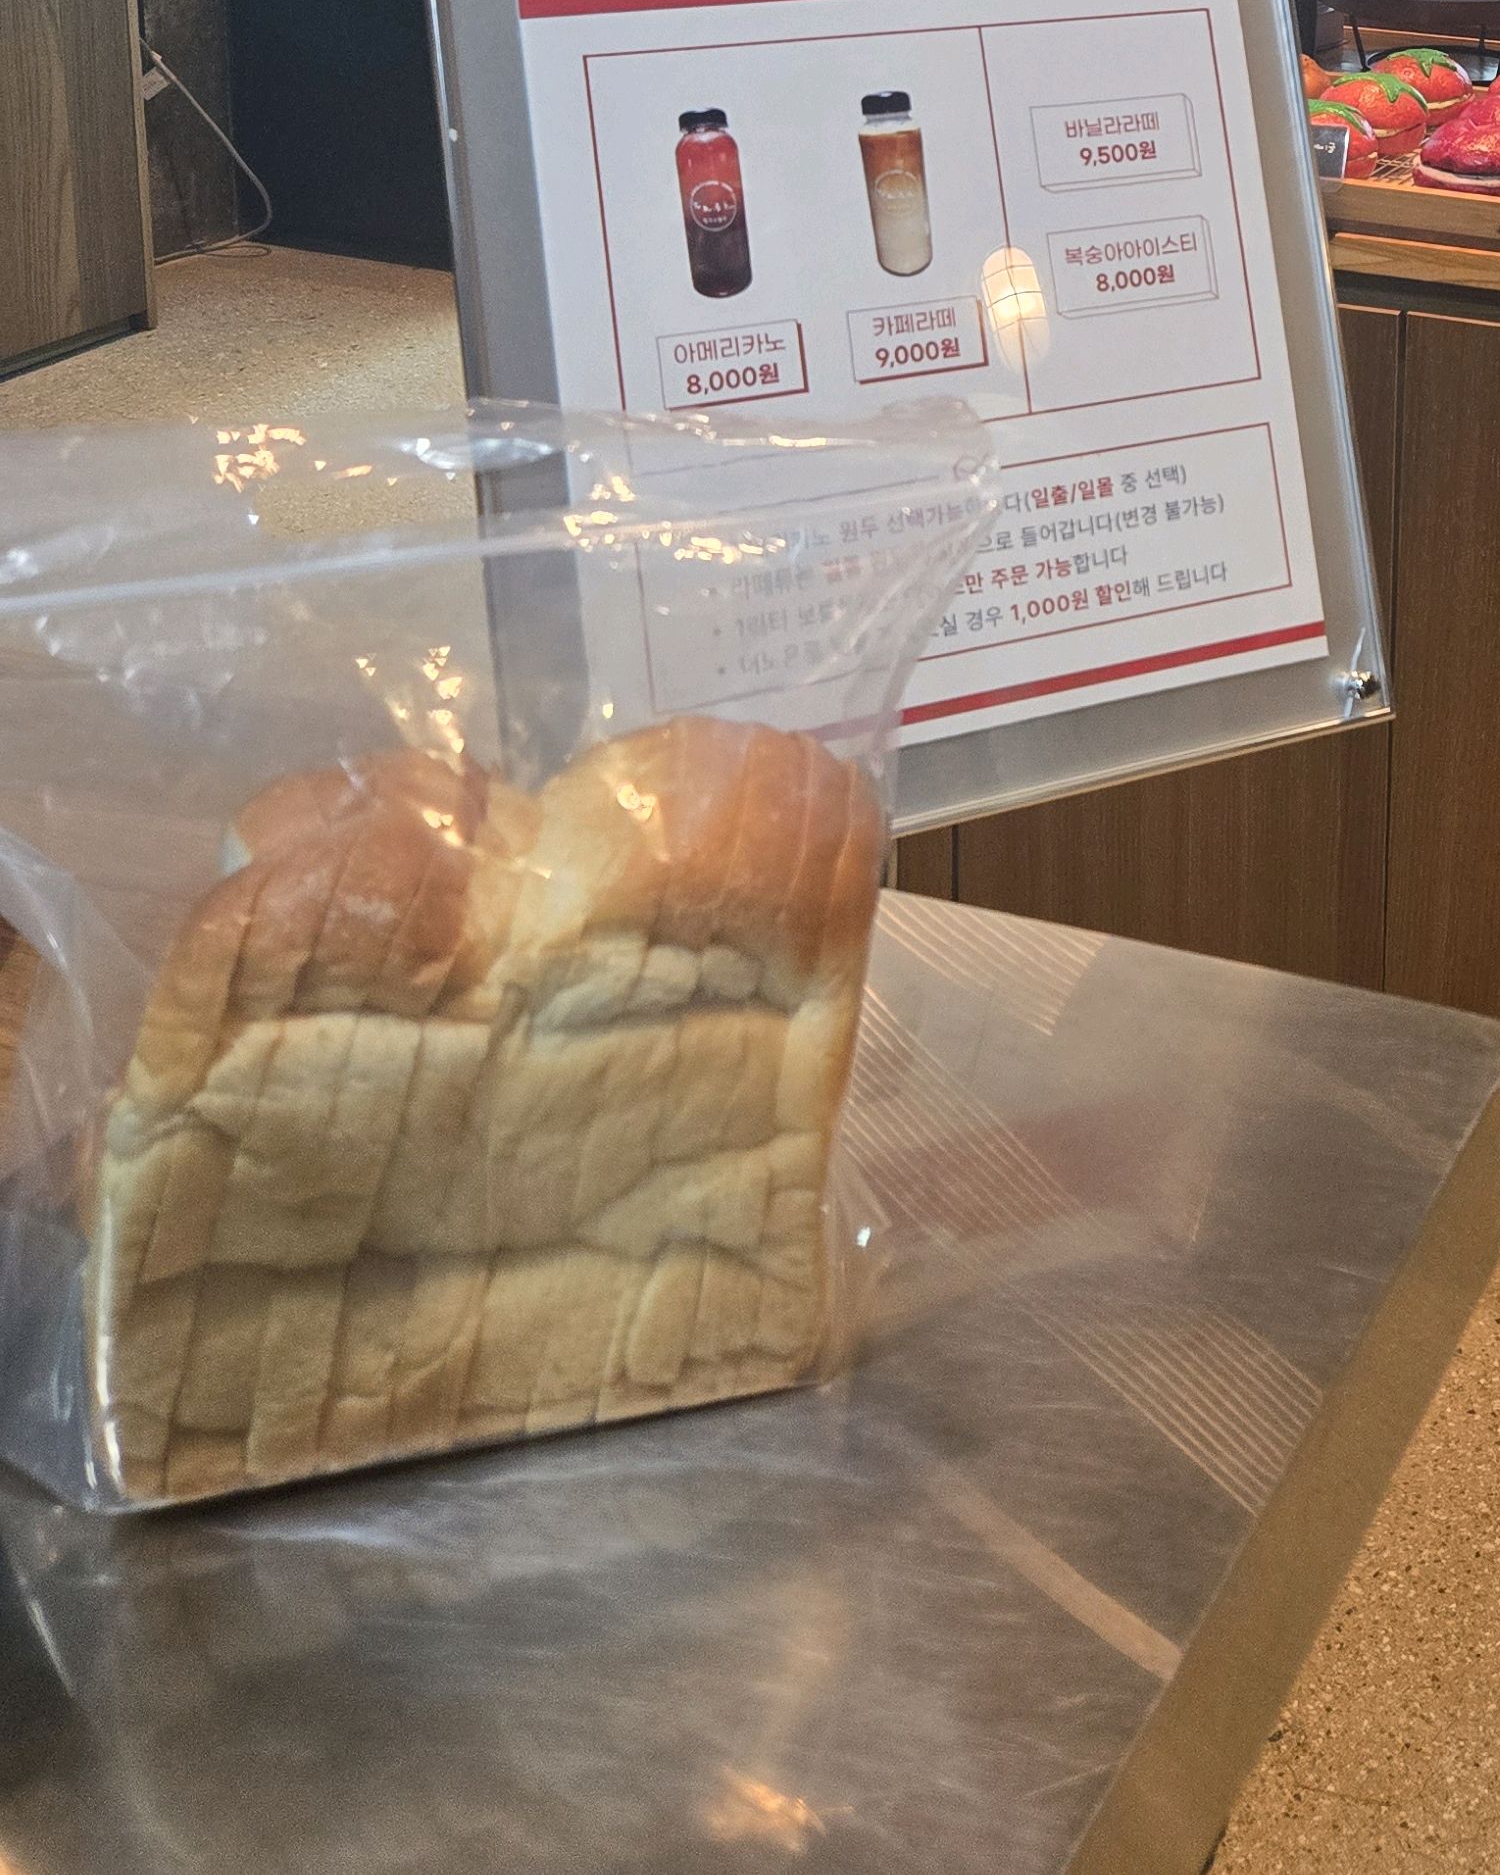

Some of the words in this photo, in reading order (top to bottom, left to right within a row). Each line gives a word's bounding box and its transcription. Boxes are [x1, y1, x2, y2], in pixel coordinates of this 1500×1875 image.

[1065, 112, 1160, 139] 바닐라라떼
[1080, 140, 1157, 167] 9,500원
[1065, 232, 1198, 266] 복숭아아이스티
[1096, 264, 1175, 292] 8,000원
[872, 307, 956, 337] 카페라떼
[674, 332, 786, 365] 아메리카노
[875, 337, 961, 368] 9,000원
[686, 363, 780, 395] 8,000원
[1120, 472, 1138, 494] 중
[1145, 464, 1187, 491] 선택)
[1021, 505, 1157, 548] 들어갑니다(변경
[1164, 492, 1224, 521] 불가능)
[991, 565, 1029, 589] 주문
[1036, 545, 1129, 580] 가능합니다
[966, 606, 1003, 632] 경우
[1010, 588, 1089, 625] 1,000원
[1096, 577, 1150, 607] 할인해
[1157, 562, 1227, 593] 드립니다
